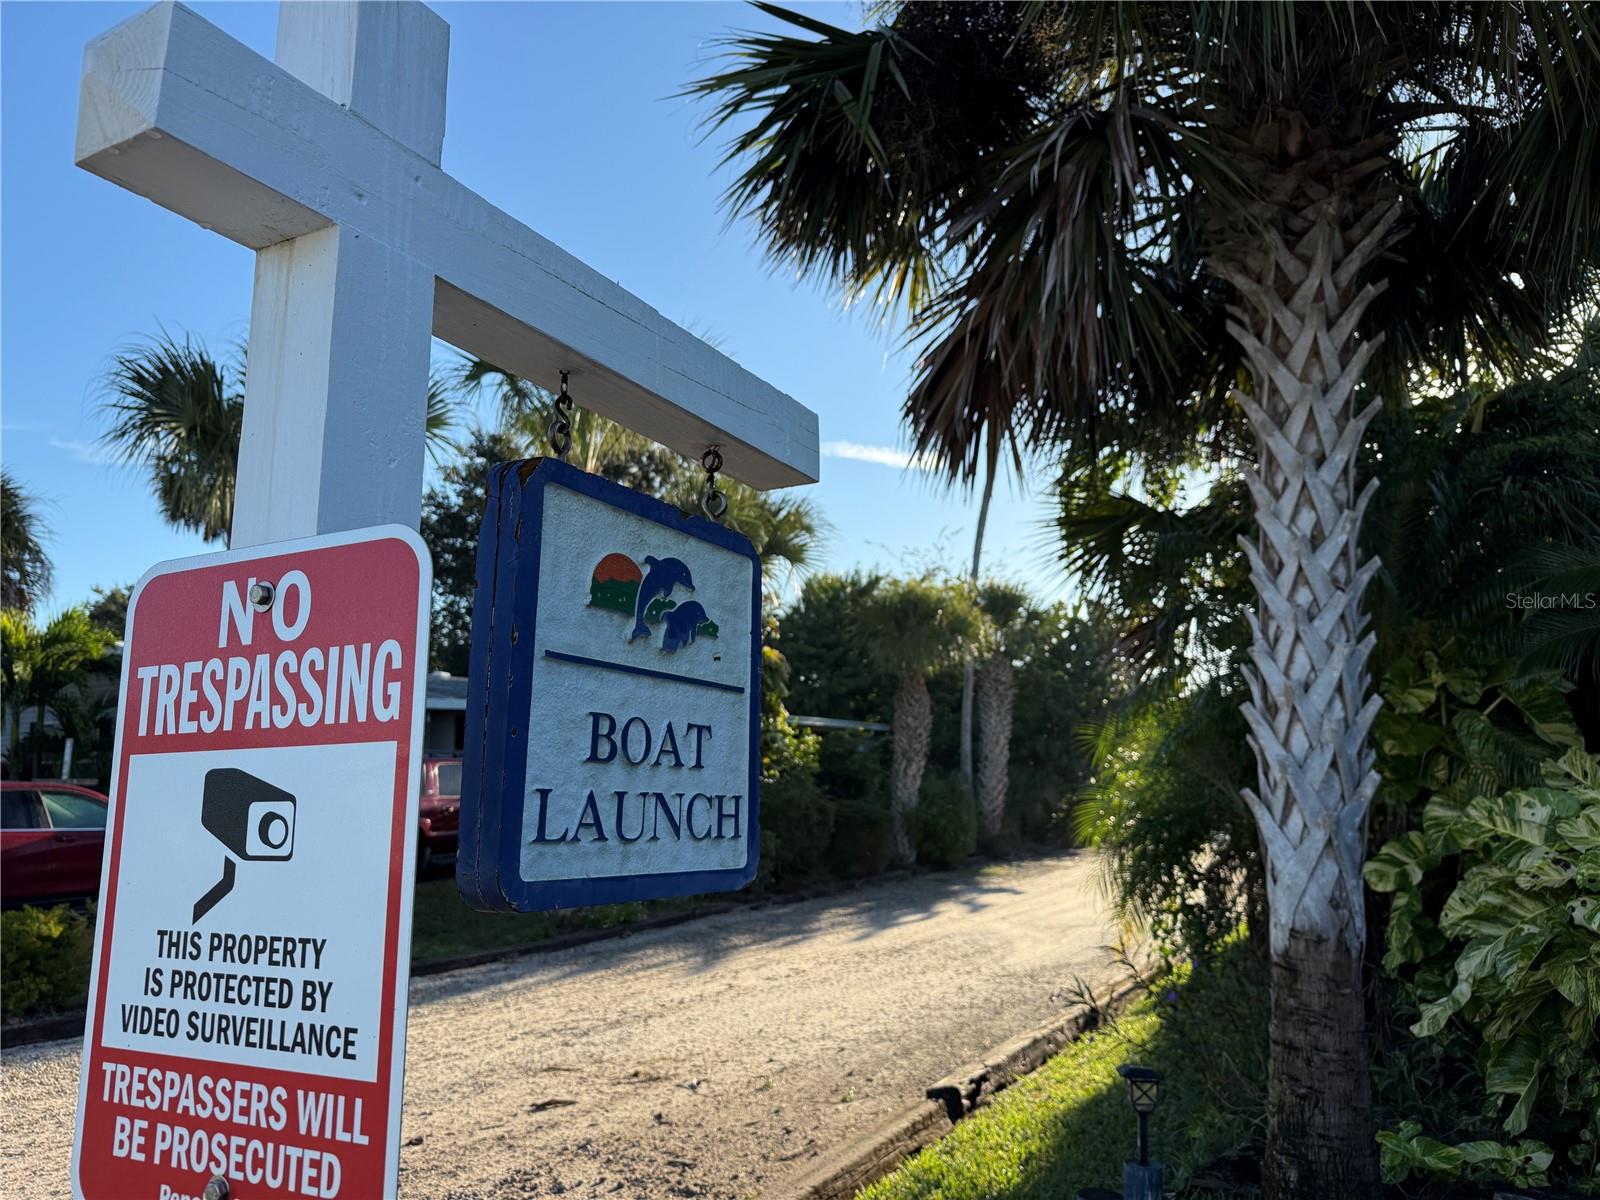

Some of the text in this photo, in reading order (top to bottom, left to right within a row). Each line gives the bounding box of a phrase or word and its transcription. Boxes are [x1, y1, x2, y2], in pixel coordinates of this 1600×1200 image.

[218, 570, 311, 648] NO
[137, 639, 402, 737] TRESPASSING
[585, 711, 713, 768] BOAT
[532, 788, 743, 842] LAUNCH
[157, 929, 327, 969] THIS PROPERTY
[143, 967, 333, 1013] IS PROTECTED BY
[121, 1003, 358, 1061] VIDEO SURVEILLANCE
[101, 1062, 370, 1146] TRESPASSERS WILL
[112, 1116, 342, 1200] BE PROSECUTED
